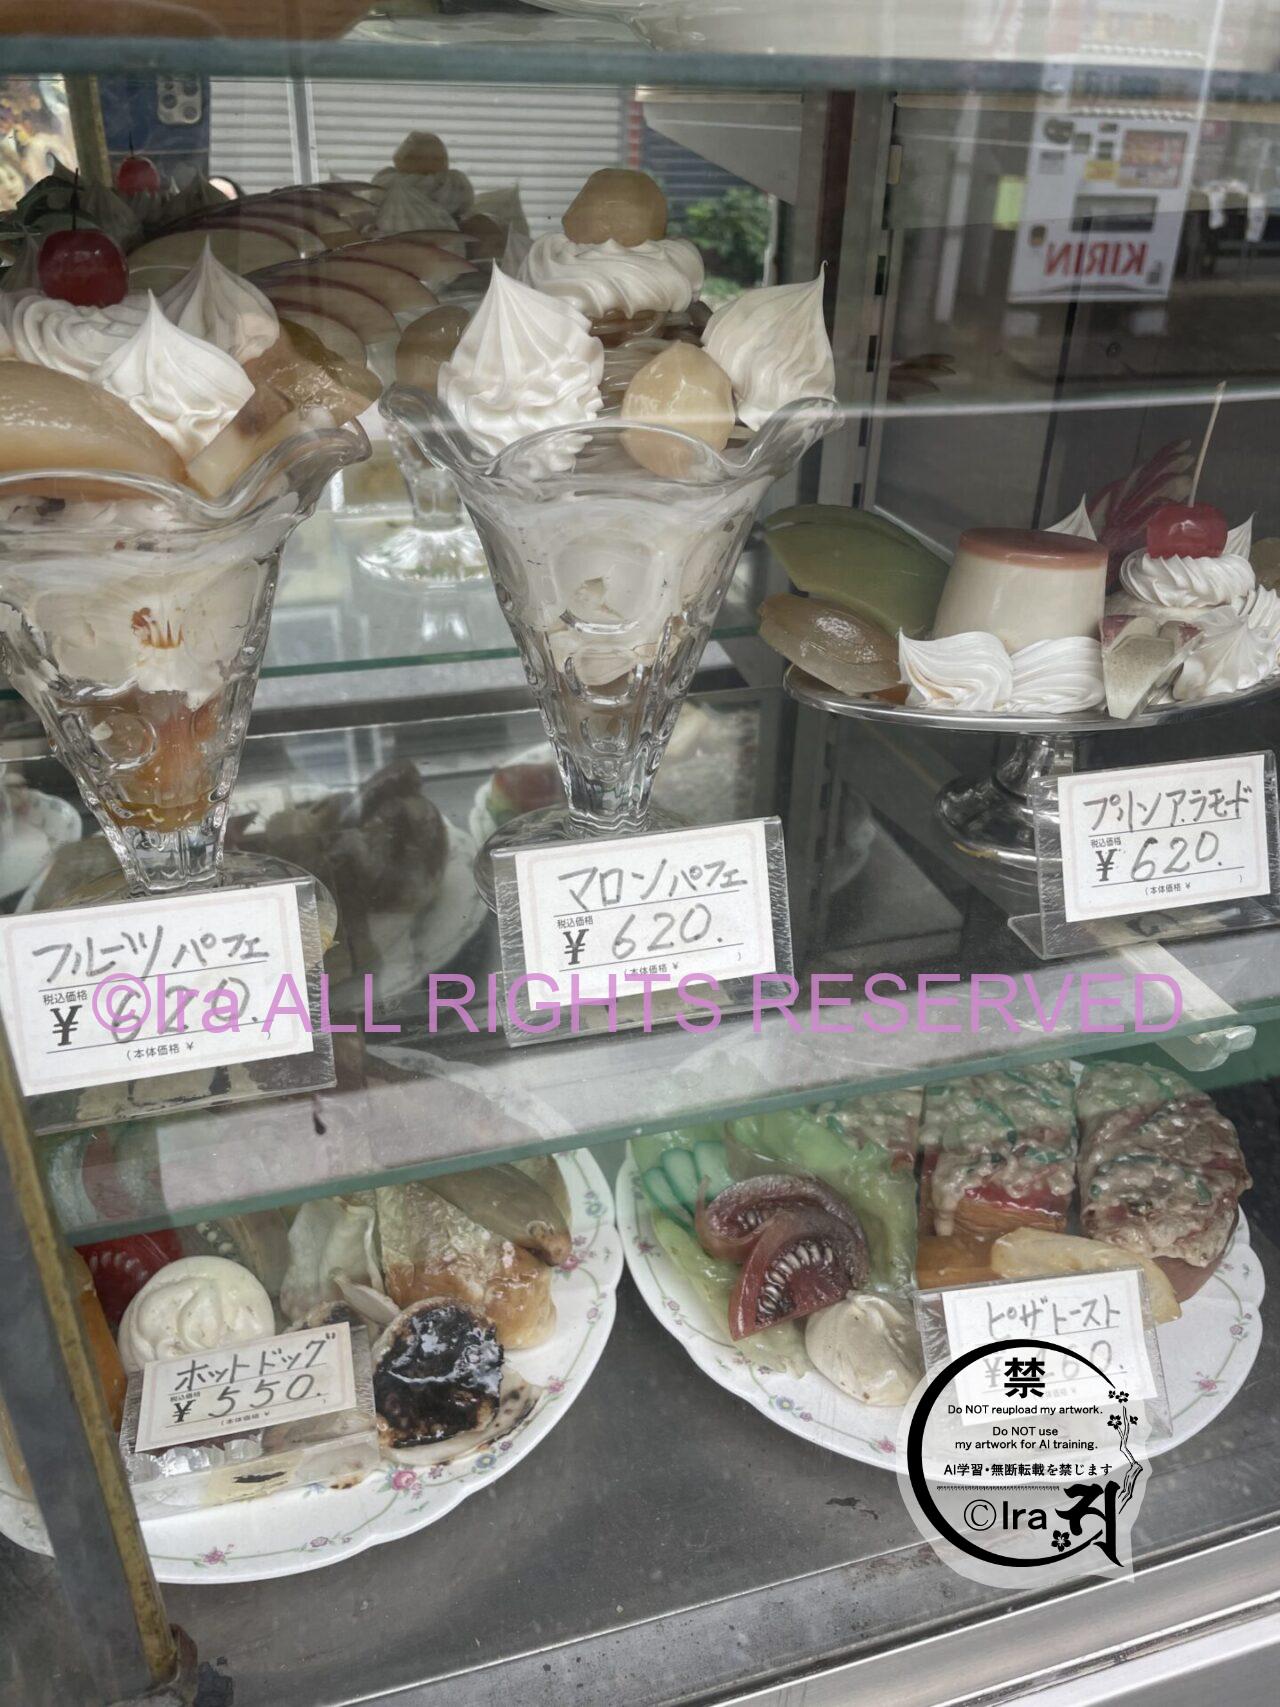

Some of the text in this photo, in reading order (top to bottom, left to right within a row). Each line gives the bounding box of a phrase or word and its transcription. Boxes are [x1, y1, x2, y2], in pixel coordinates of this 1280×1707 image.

[558, 858, 748, 912] マロンパフェ
[557, 915, 594, 929] 税込価格
[32, 925, 270, 983] フルーツパフェ
[43, 989, 88, 1006] 税込価格
[987, 1294, 1121, 1341] ピザトースト
[174, 1332, 336, 1392] ホットドッグ
